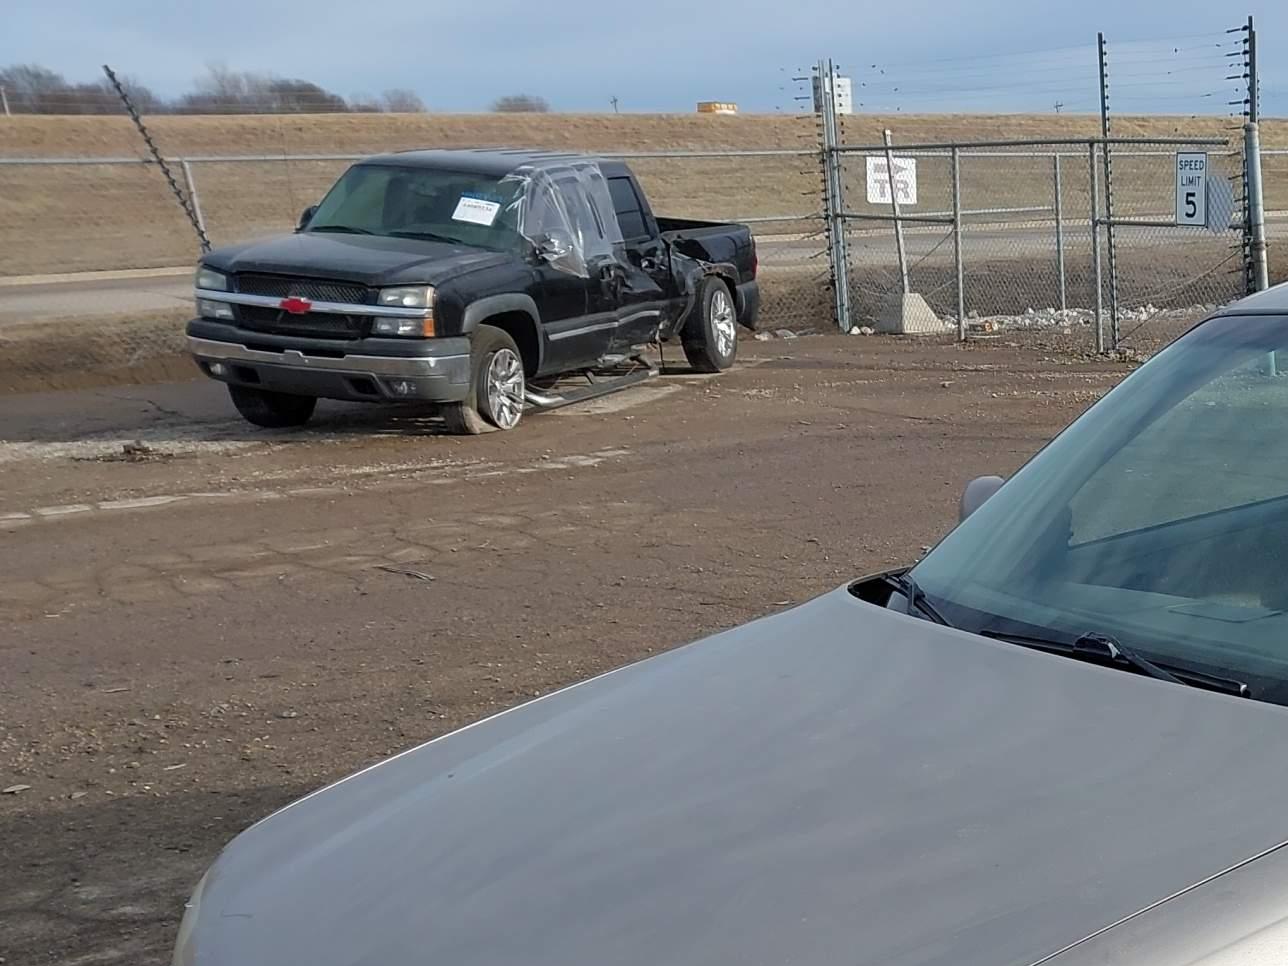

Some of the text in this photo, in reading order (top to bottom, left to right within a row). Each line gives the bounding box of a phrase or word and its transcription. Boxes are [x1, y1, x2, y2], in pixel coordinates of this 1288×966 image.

[1179, 160, 1204, 171] SPEED
[1181, 176, 1202, 187] LIMIT
[1185, 192, 1197, 218] 5
